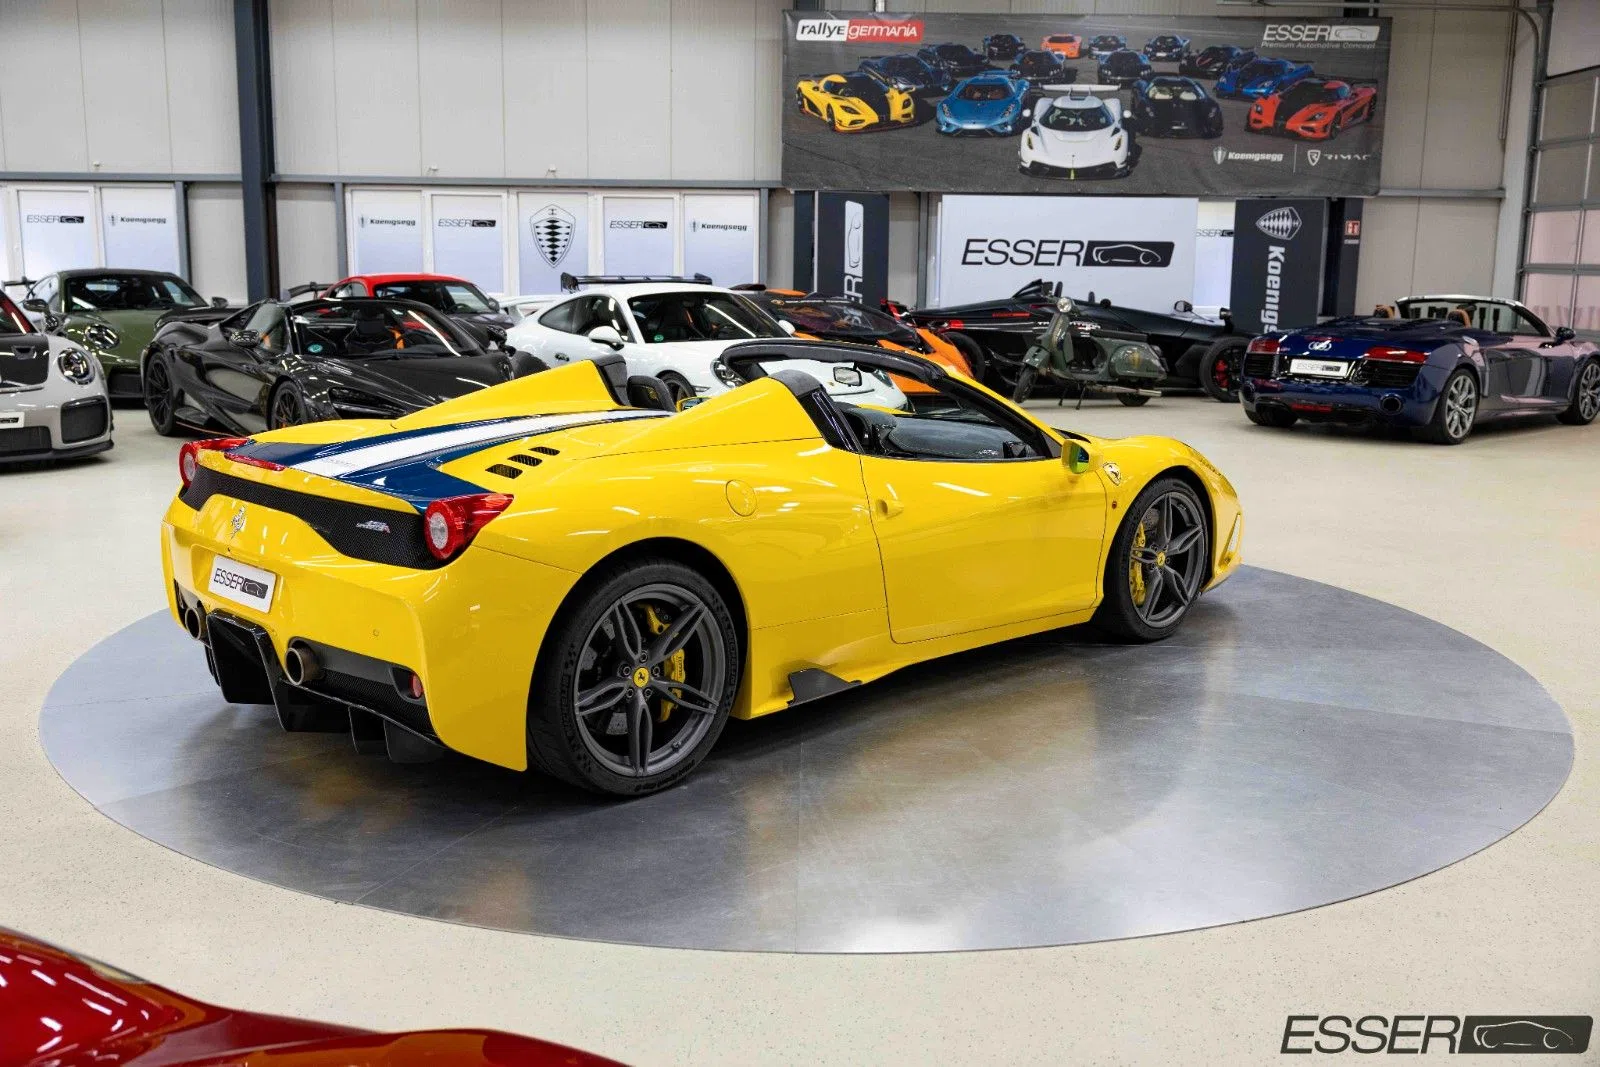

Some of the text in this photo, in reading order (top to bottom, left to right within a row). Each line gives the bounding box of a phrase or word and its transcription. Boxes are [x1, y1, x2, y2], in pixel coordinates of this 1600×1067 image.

[1263, 24, 1331, 41] ESSER
[1261, 41, 1295, 49] Premium
[1343, 42, 1376, 50] Concept
[1228, 151, 1284, 162] Koenigsegg
[1323, 153, 1372, 161] RIMAC
[26, 214, 61, 224] ESSER
[120, 215, 167, 225] Koenigsegg
[369, 218, 416, 226] Koenigsegg
[438, 218, 472, 227] ESSER
[609, 220, 644, 229] ESSER
[701, 222, 748, 232] Koenigsegg
[961, 238, 1085, 267] ESSER
[213, 567, 245, 591] ESSER
